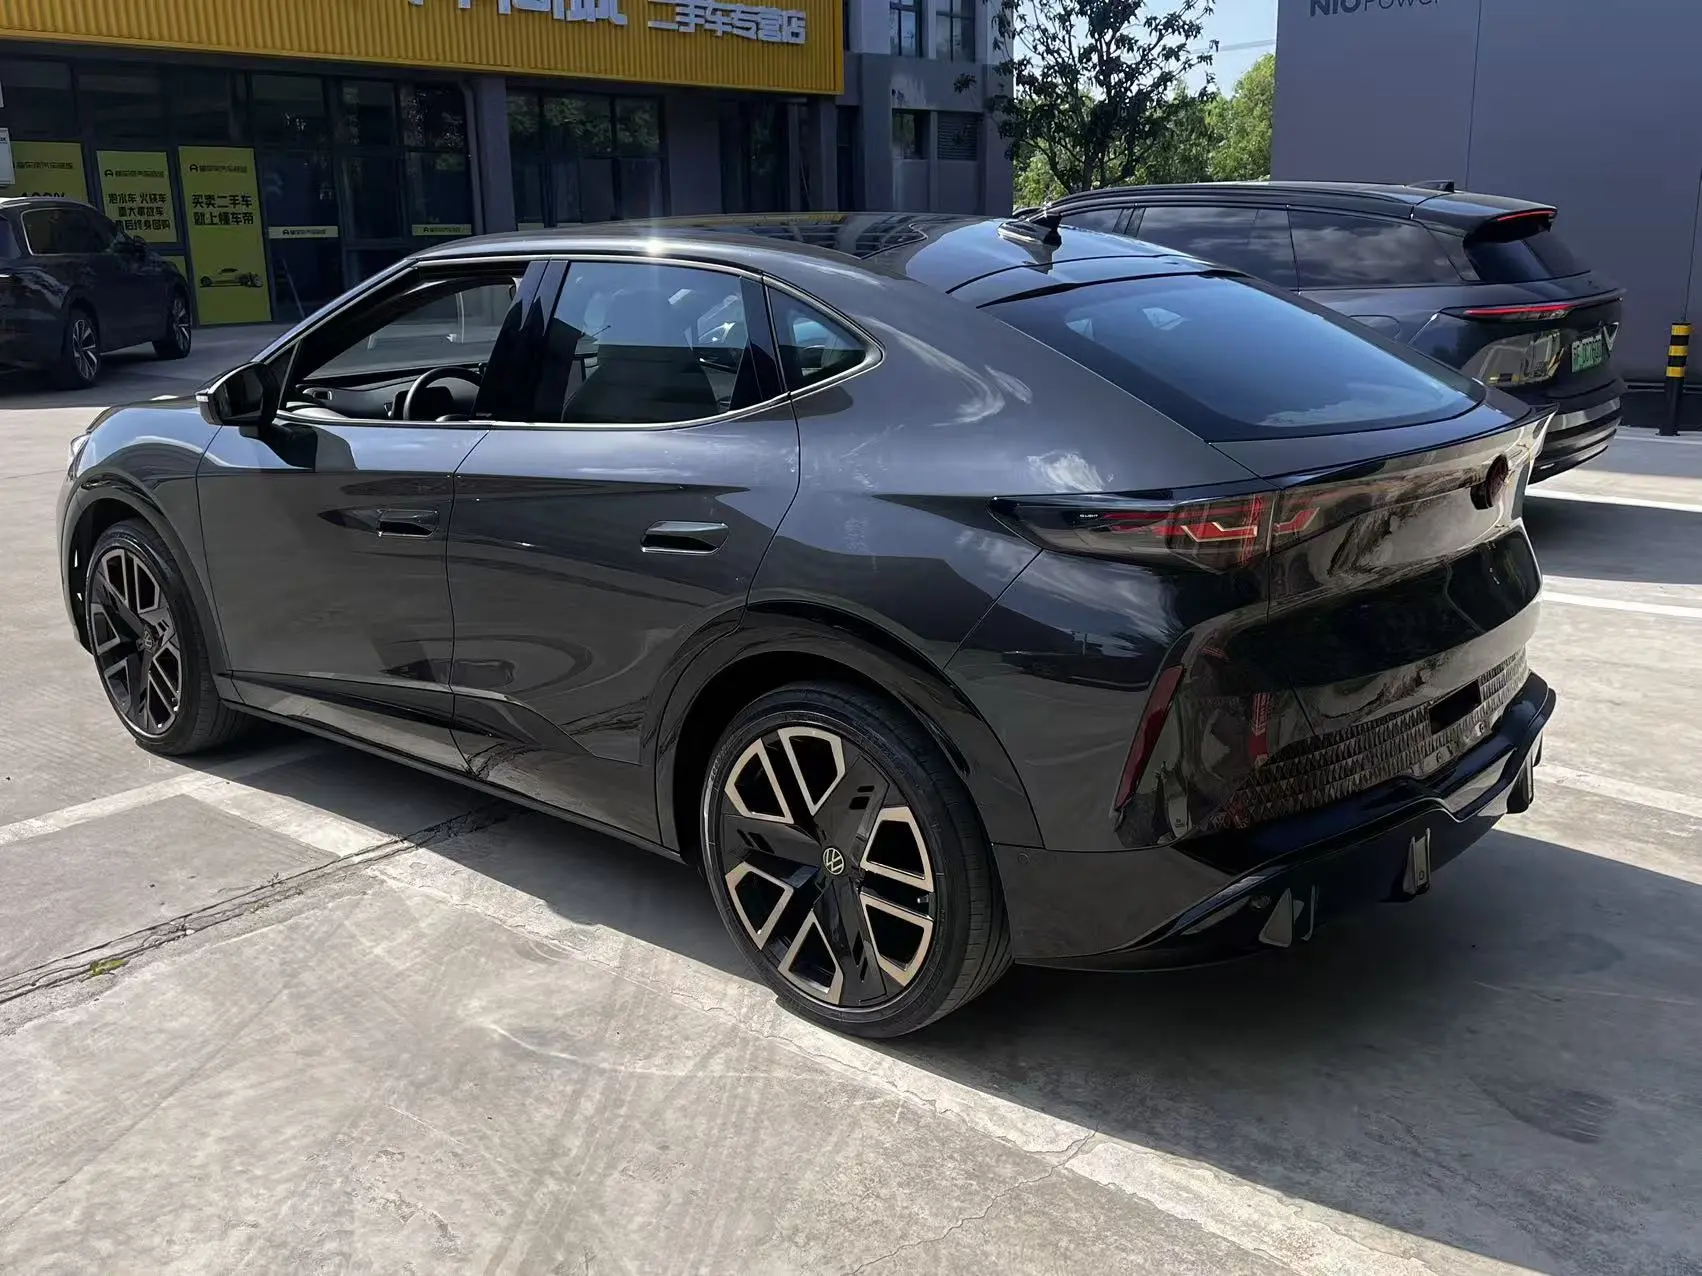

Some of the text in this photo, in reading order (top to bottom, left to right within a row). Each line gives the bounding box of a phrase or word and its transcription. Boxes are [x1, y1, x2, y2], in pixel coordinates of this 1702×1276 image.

[648, 0, 806, 44] 二手车专营店
[192, 194, 253, 209] 买卖二手车
[193, 211, 254, 225] 就上懂车帝
